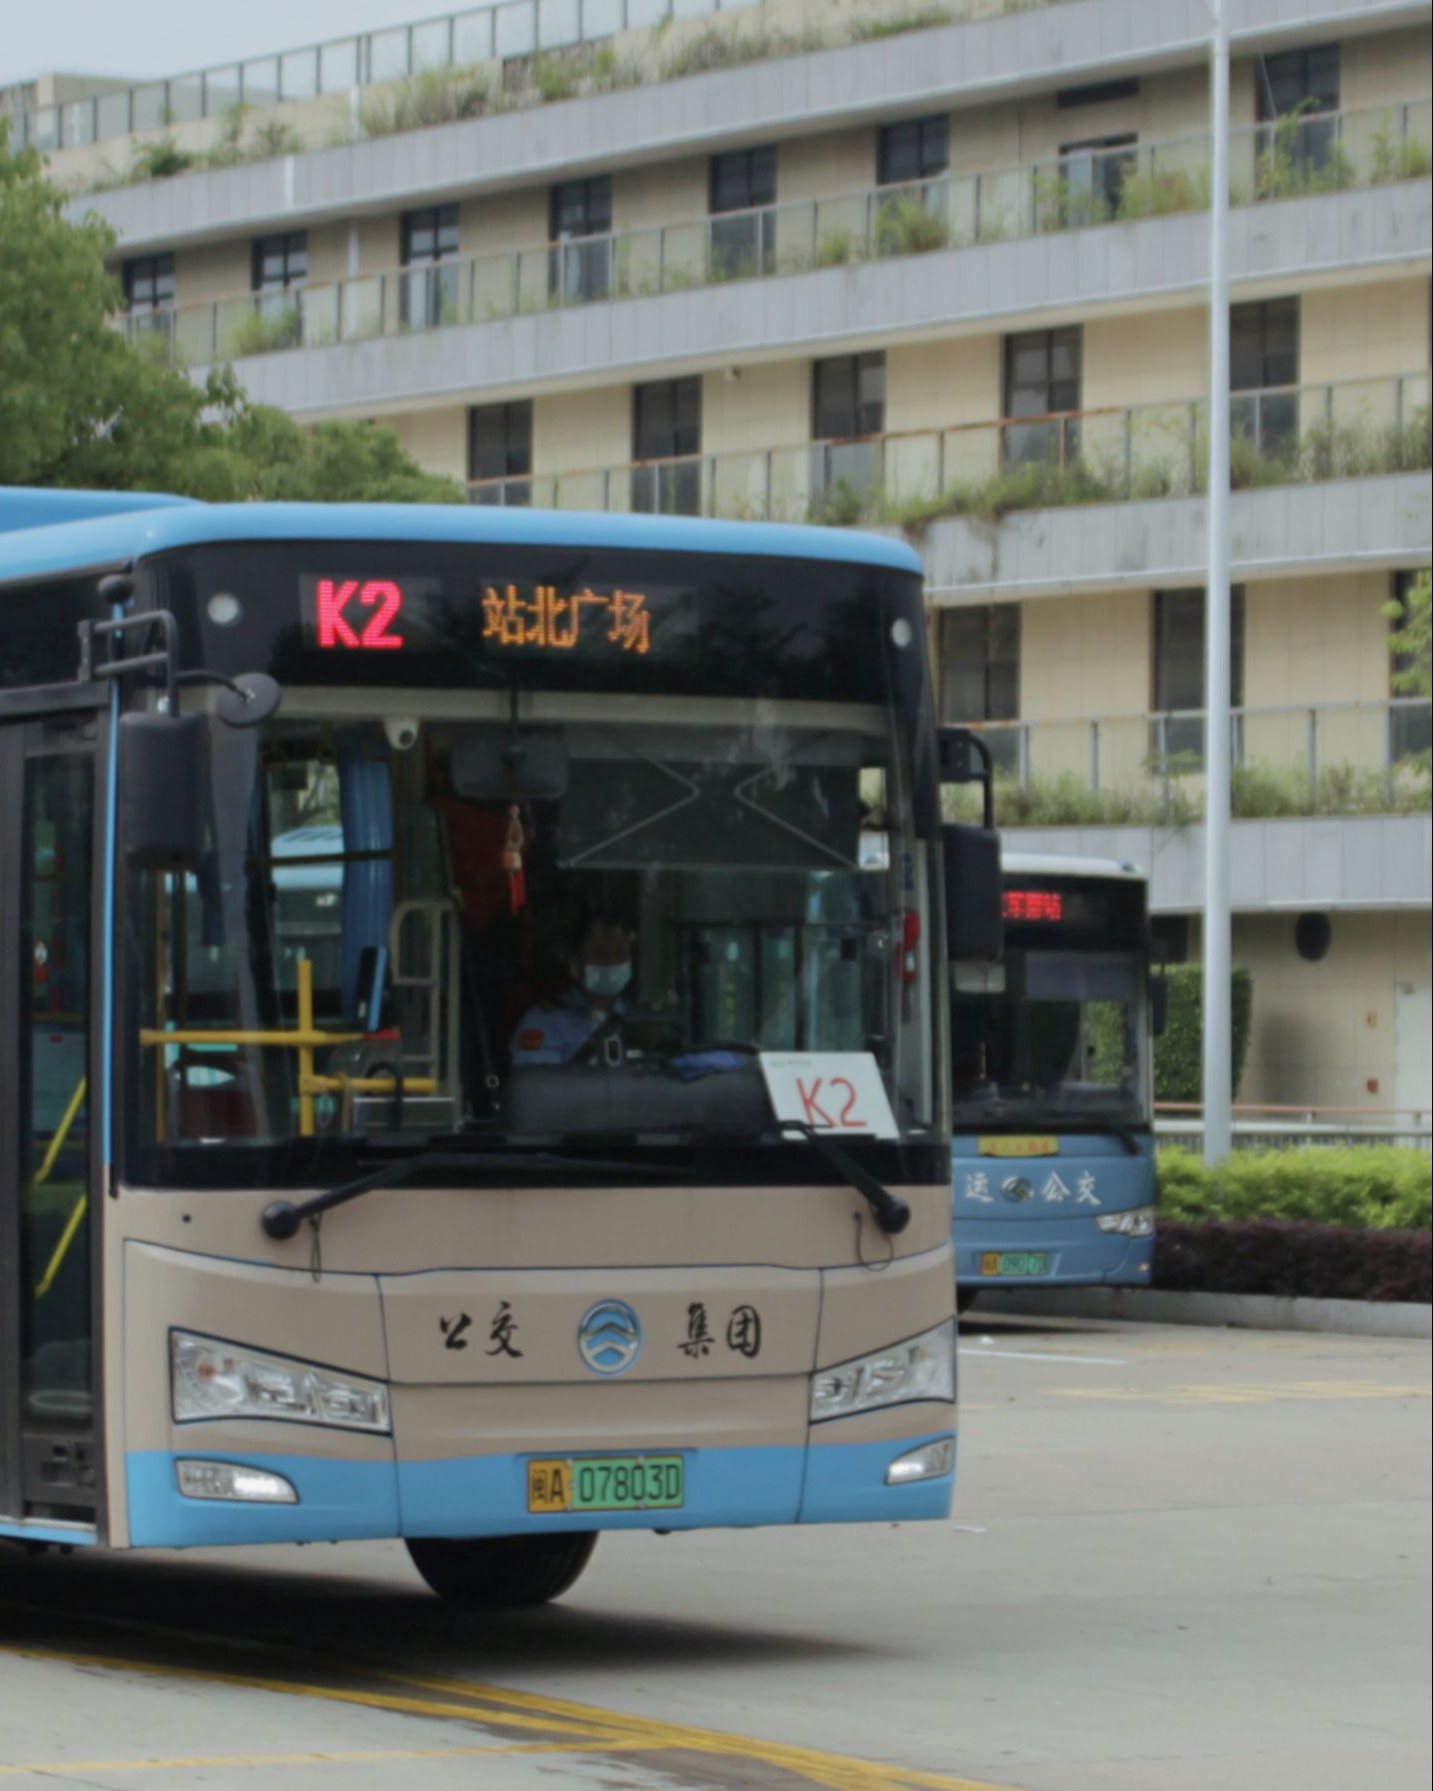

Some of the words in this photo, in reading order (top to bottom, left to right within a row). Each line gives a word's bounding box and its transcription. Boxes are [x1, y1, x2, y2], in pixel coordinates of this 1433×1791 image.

[318, 579, 404, 649] K2
[482, 584, 650, 654] 站北广场
[796, 1075, 868, 1136] K2
[1042, 1169, 1102, 1206] 公交
[440, 1301, 523, 1359] 公交
[677, 1303, 762, 1359] 集团
[579, 1464, 681, 1503] 07803D
